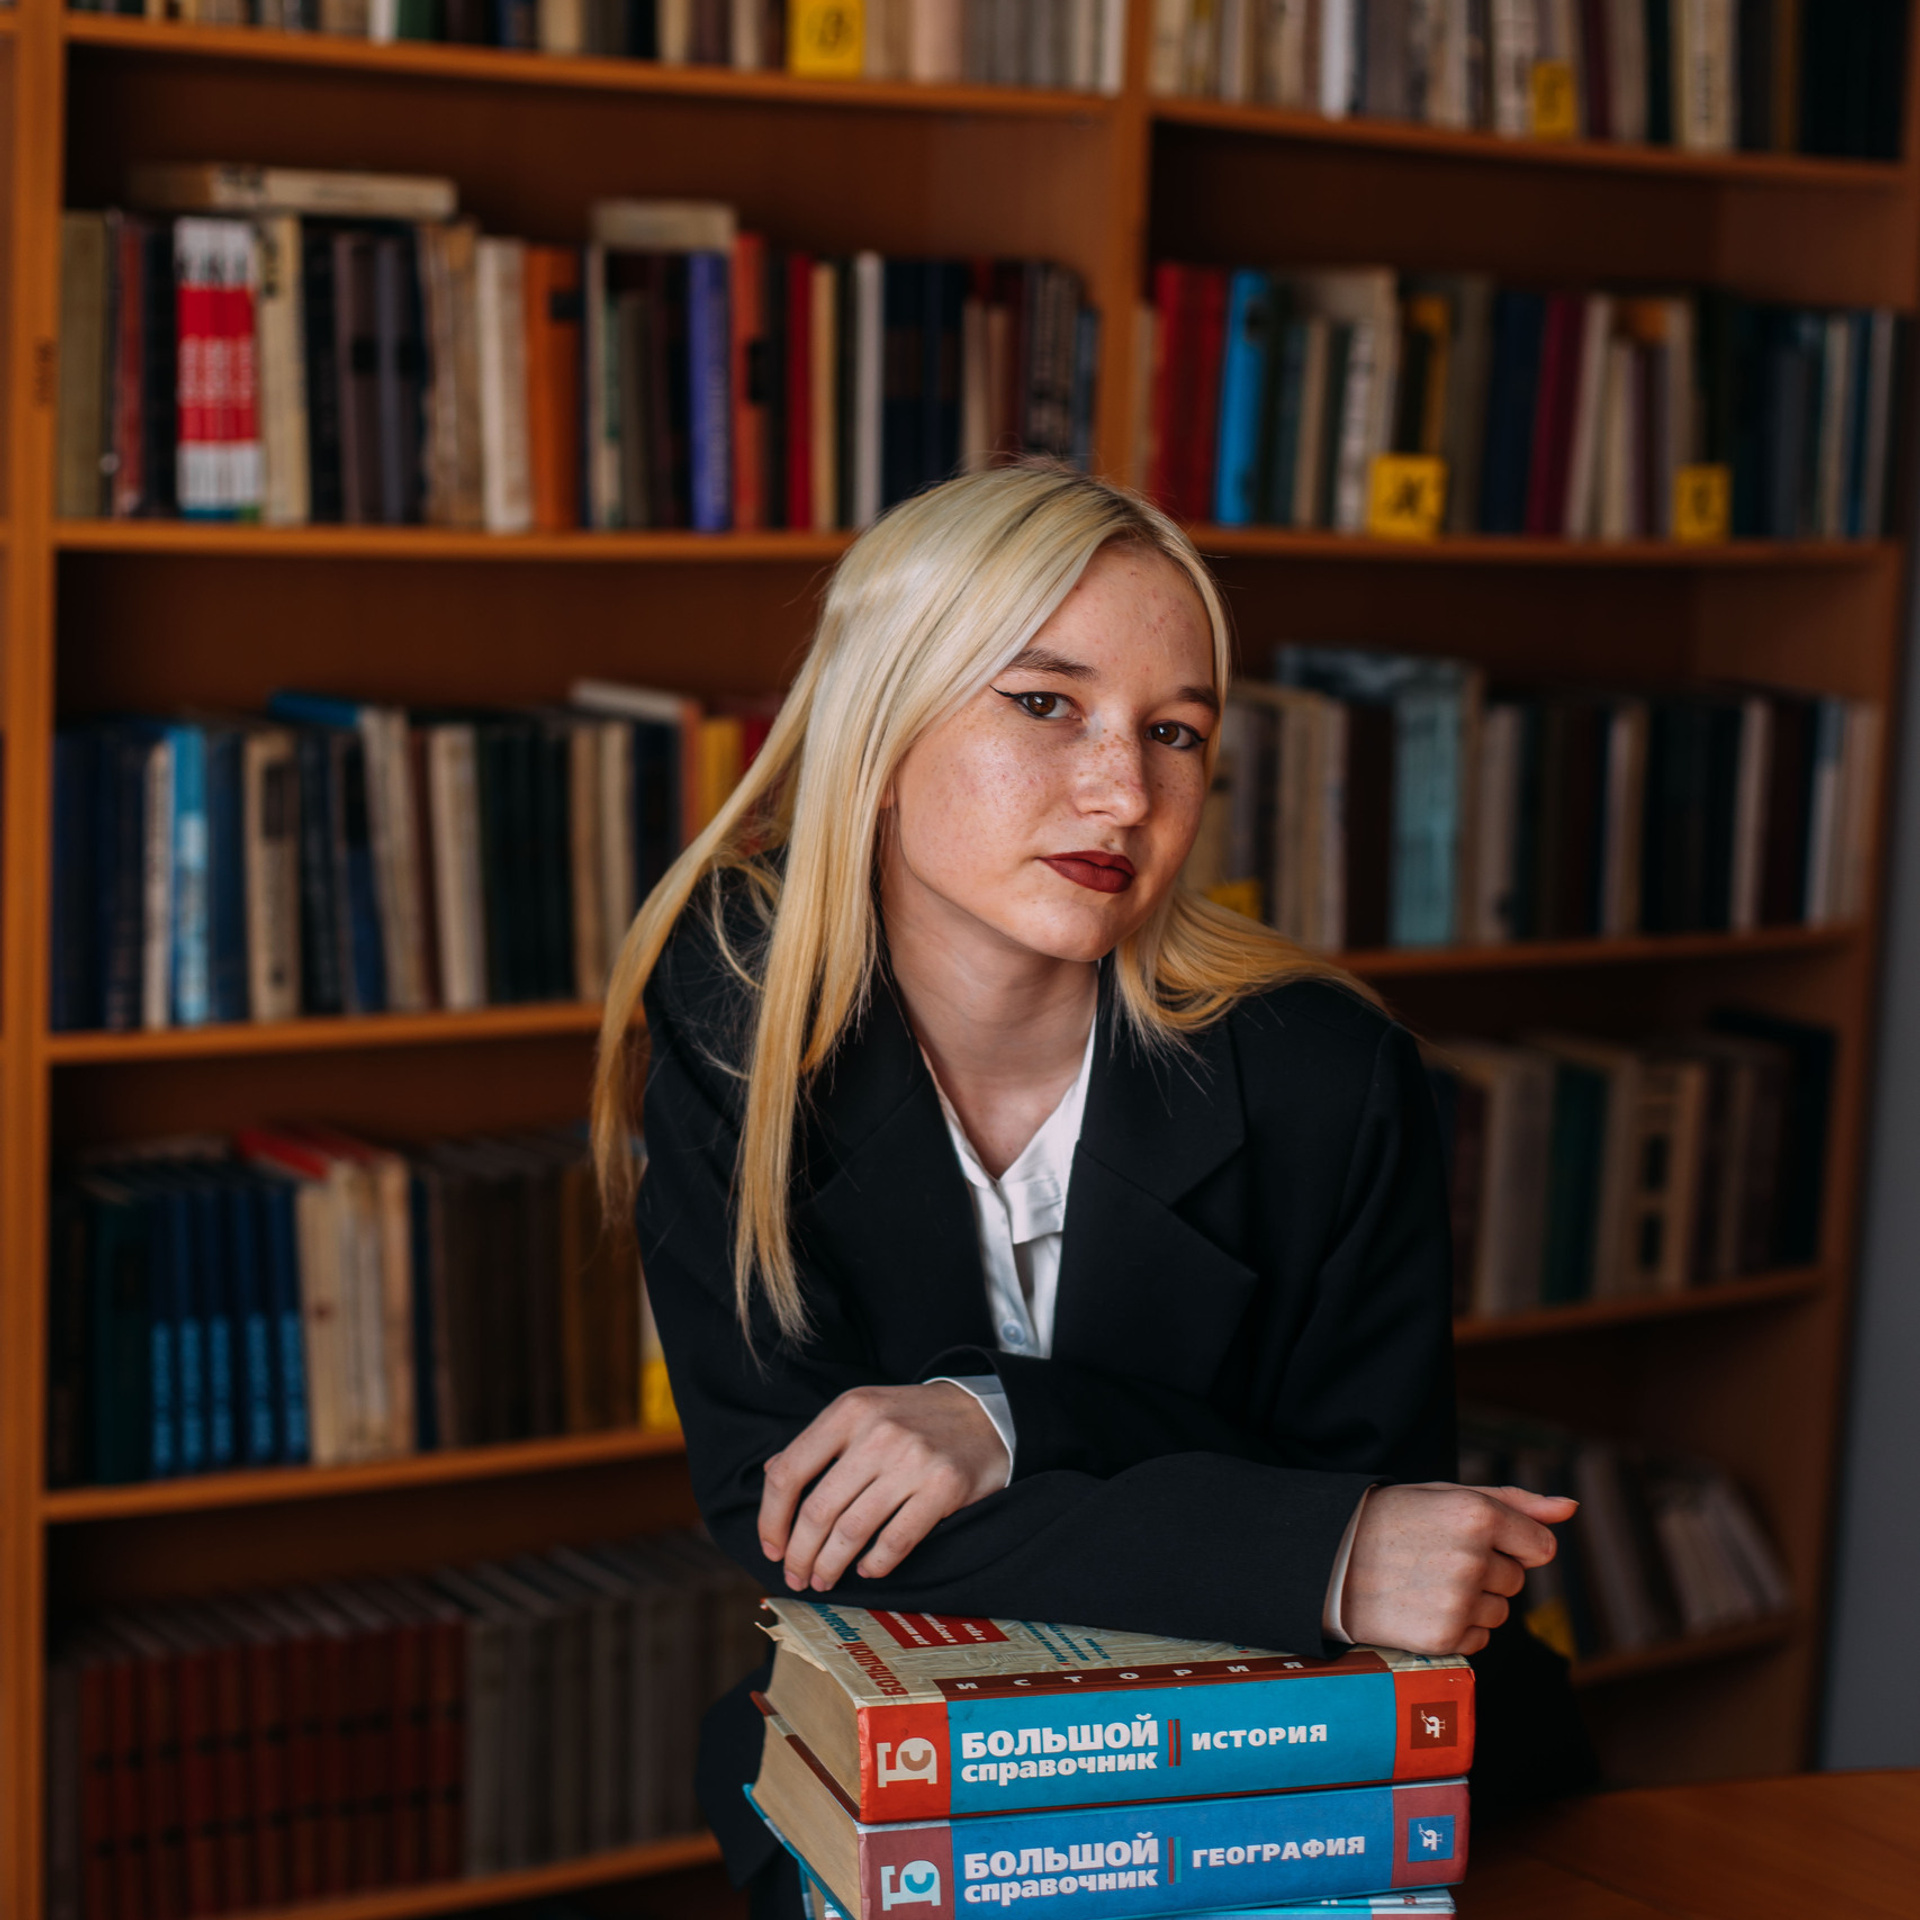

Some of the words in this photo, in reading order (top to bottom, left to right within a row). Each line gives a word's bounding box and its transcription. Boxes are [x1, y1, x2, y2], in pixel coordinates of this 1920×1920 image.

[807, 1601, 862, 1642] справочн
[836, 1641, 909, 1696] БОЛЬШОЙ
[961, 1713, 1159, 1759] БОЛЬШОЙ
[1192, 1724, 1329, 1751] ИСТОРИЯ
[961, 1752, 1158, 1786] справочник
[964, 1832, 1159, 1880] БОЛЬШОЙ
[1192, 1836, 1365, 1868] ГЕОГРАФИЯ
[964, 1869, 1158, 1907] справочник
